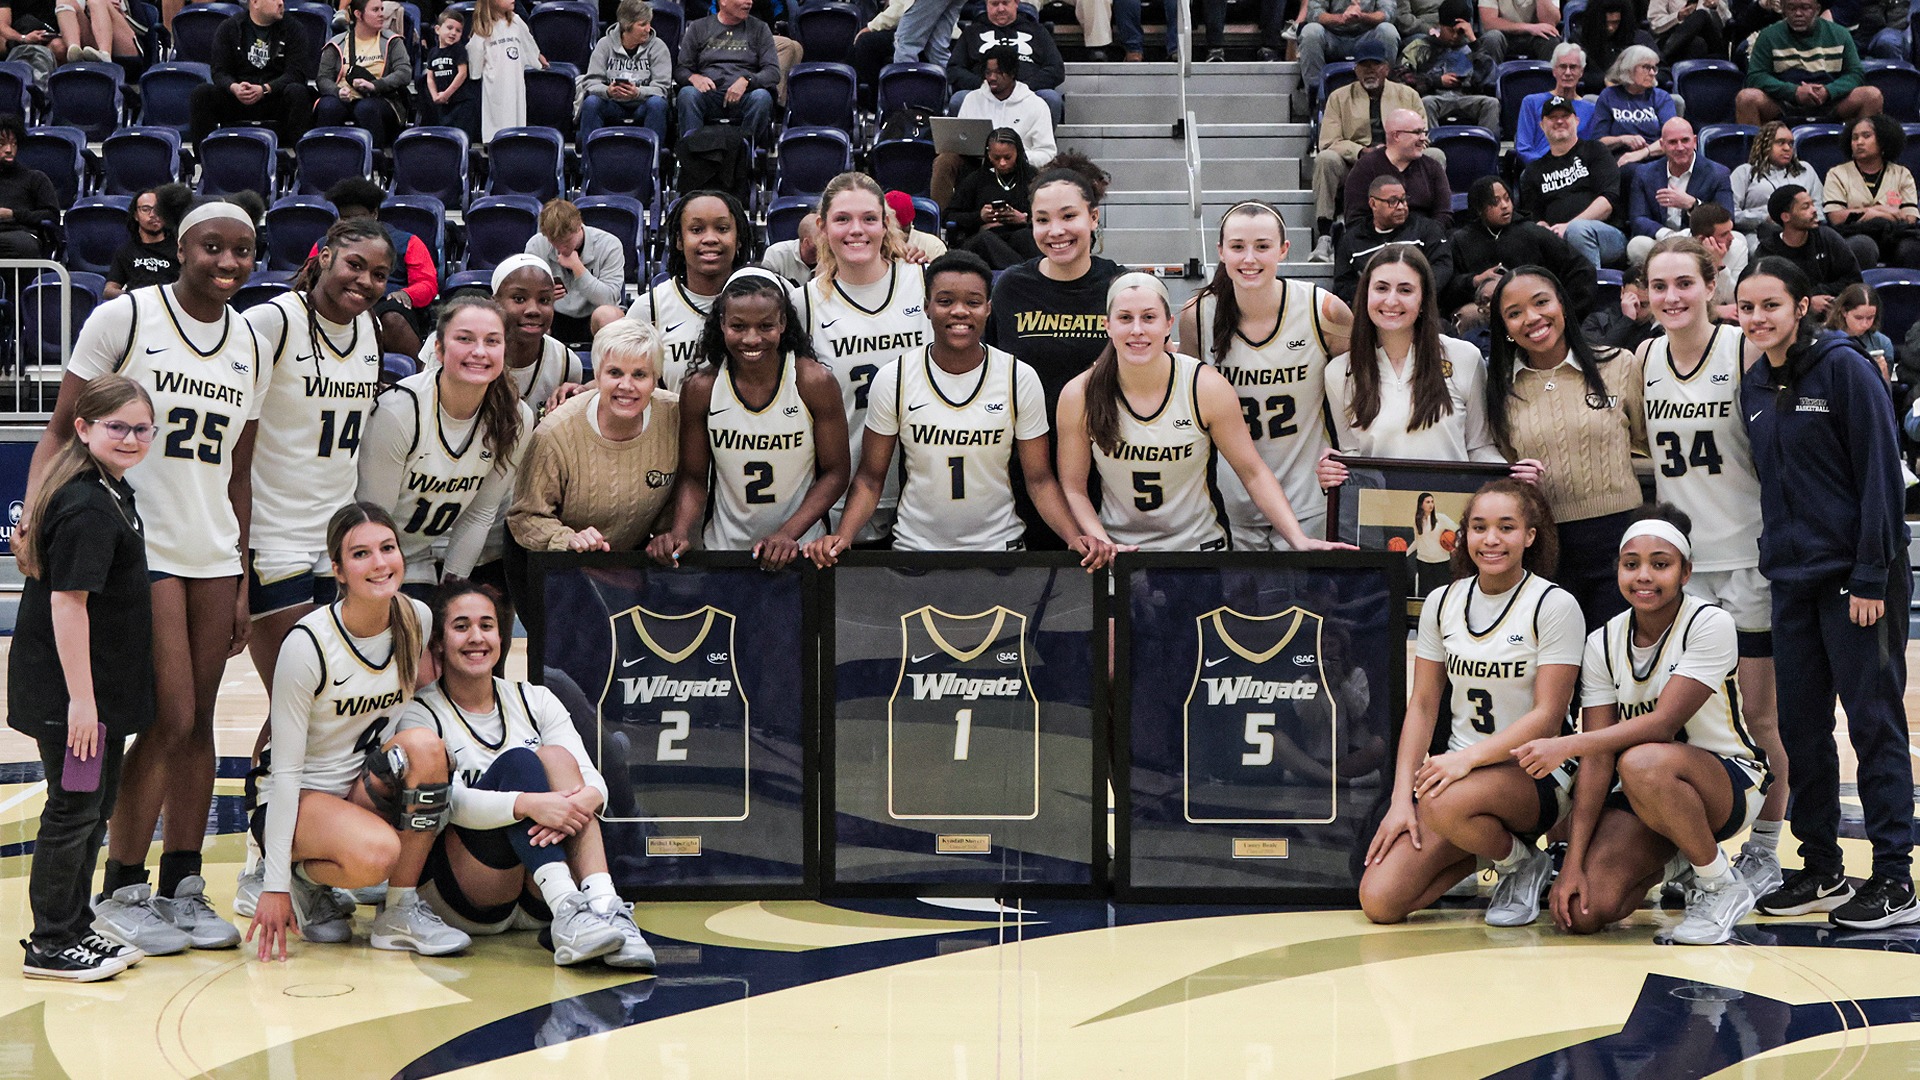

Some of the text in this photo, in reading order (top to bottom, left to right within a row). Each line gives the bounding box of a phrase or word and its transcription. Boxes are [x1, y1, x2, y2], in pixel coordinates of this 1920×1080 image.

[1612, 106, 1658, 121] BOON
[1541, 166, 1590, 193] BULLDOGS
[1542, 159, 1583, 183] WINGATE
[1014, 311, 1107, 333] WINGATE
[830, 331, 924, 358] WINGATE
[1289, 339, 1306, 348] SAC
[151, 369, 244, 408] WINGATE
[988, 403, 1003, 411] SAC
[1646, 399, 1733, 420] WINGATE
[163, 405, 231, 466] 25
[316, 410, 363, 459] 14
[909, 424, 1005, 446] WINGATE
[1175, 419, 1192, 427] SAC
[709, 428, 805, 450] WINGATE
[1655, 430, 1723, 477] 34
[743, 461, 777, 504] 2
[947, 456, 966, 500] 1
[1131, 471, 1164, 512] 5
[403, 497, 462, 536] 10
[709, 652, 728, 661] SAC
[999, 652, 1018, 661] SAC
[1295, 654, 1315, 663] SAC
[617, 675, 732, 704] Wingate
[906, 673, 1022, 700] Wingate
[1201, 676, 1318, 705] Wingate
[333, 689, 405, 716] WINGA
[1466, 688, 1496, 735] 3
[656, 710, 690, 762] 2
[953, 708, 972, 761] 1
[1242, 712, 1276, 766] 5
